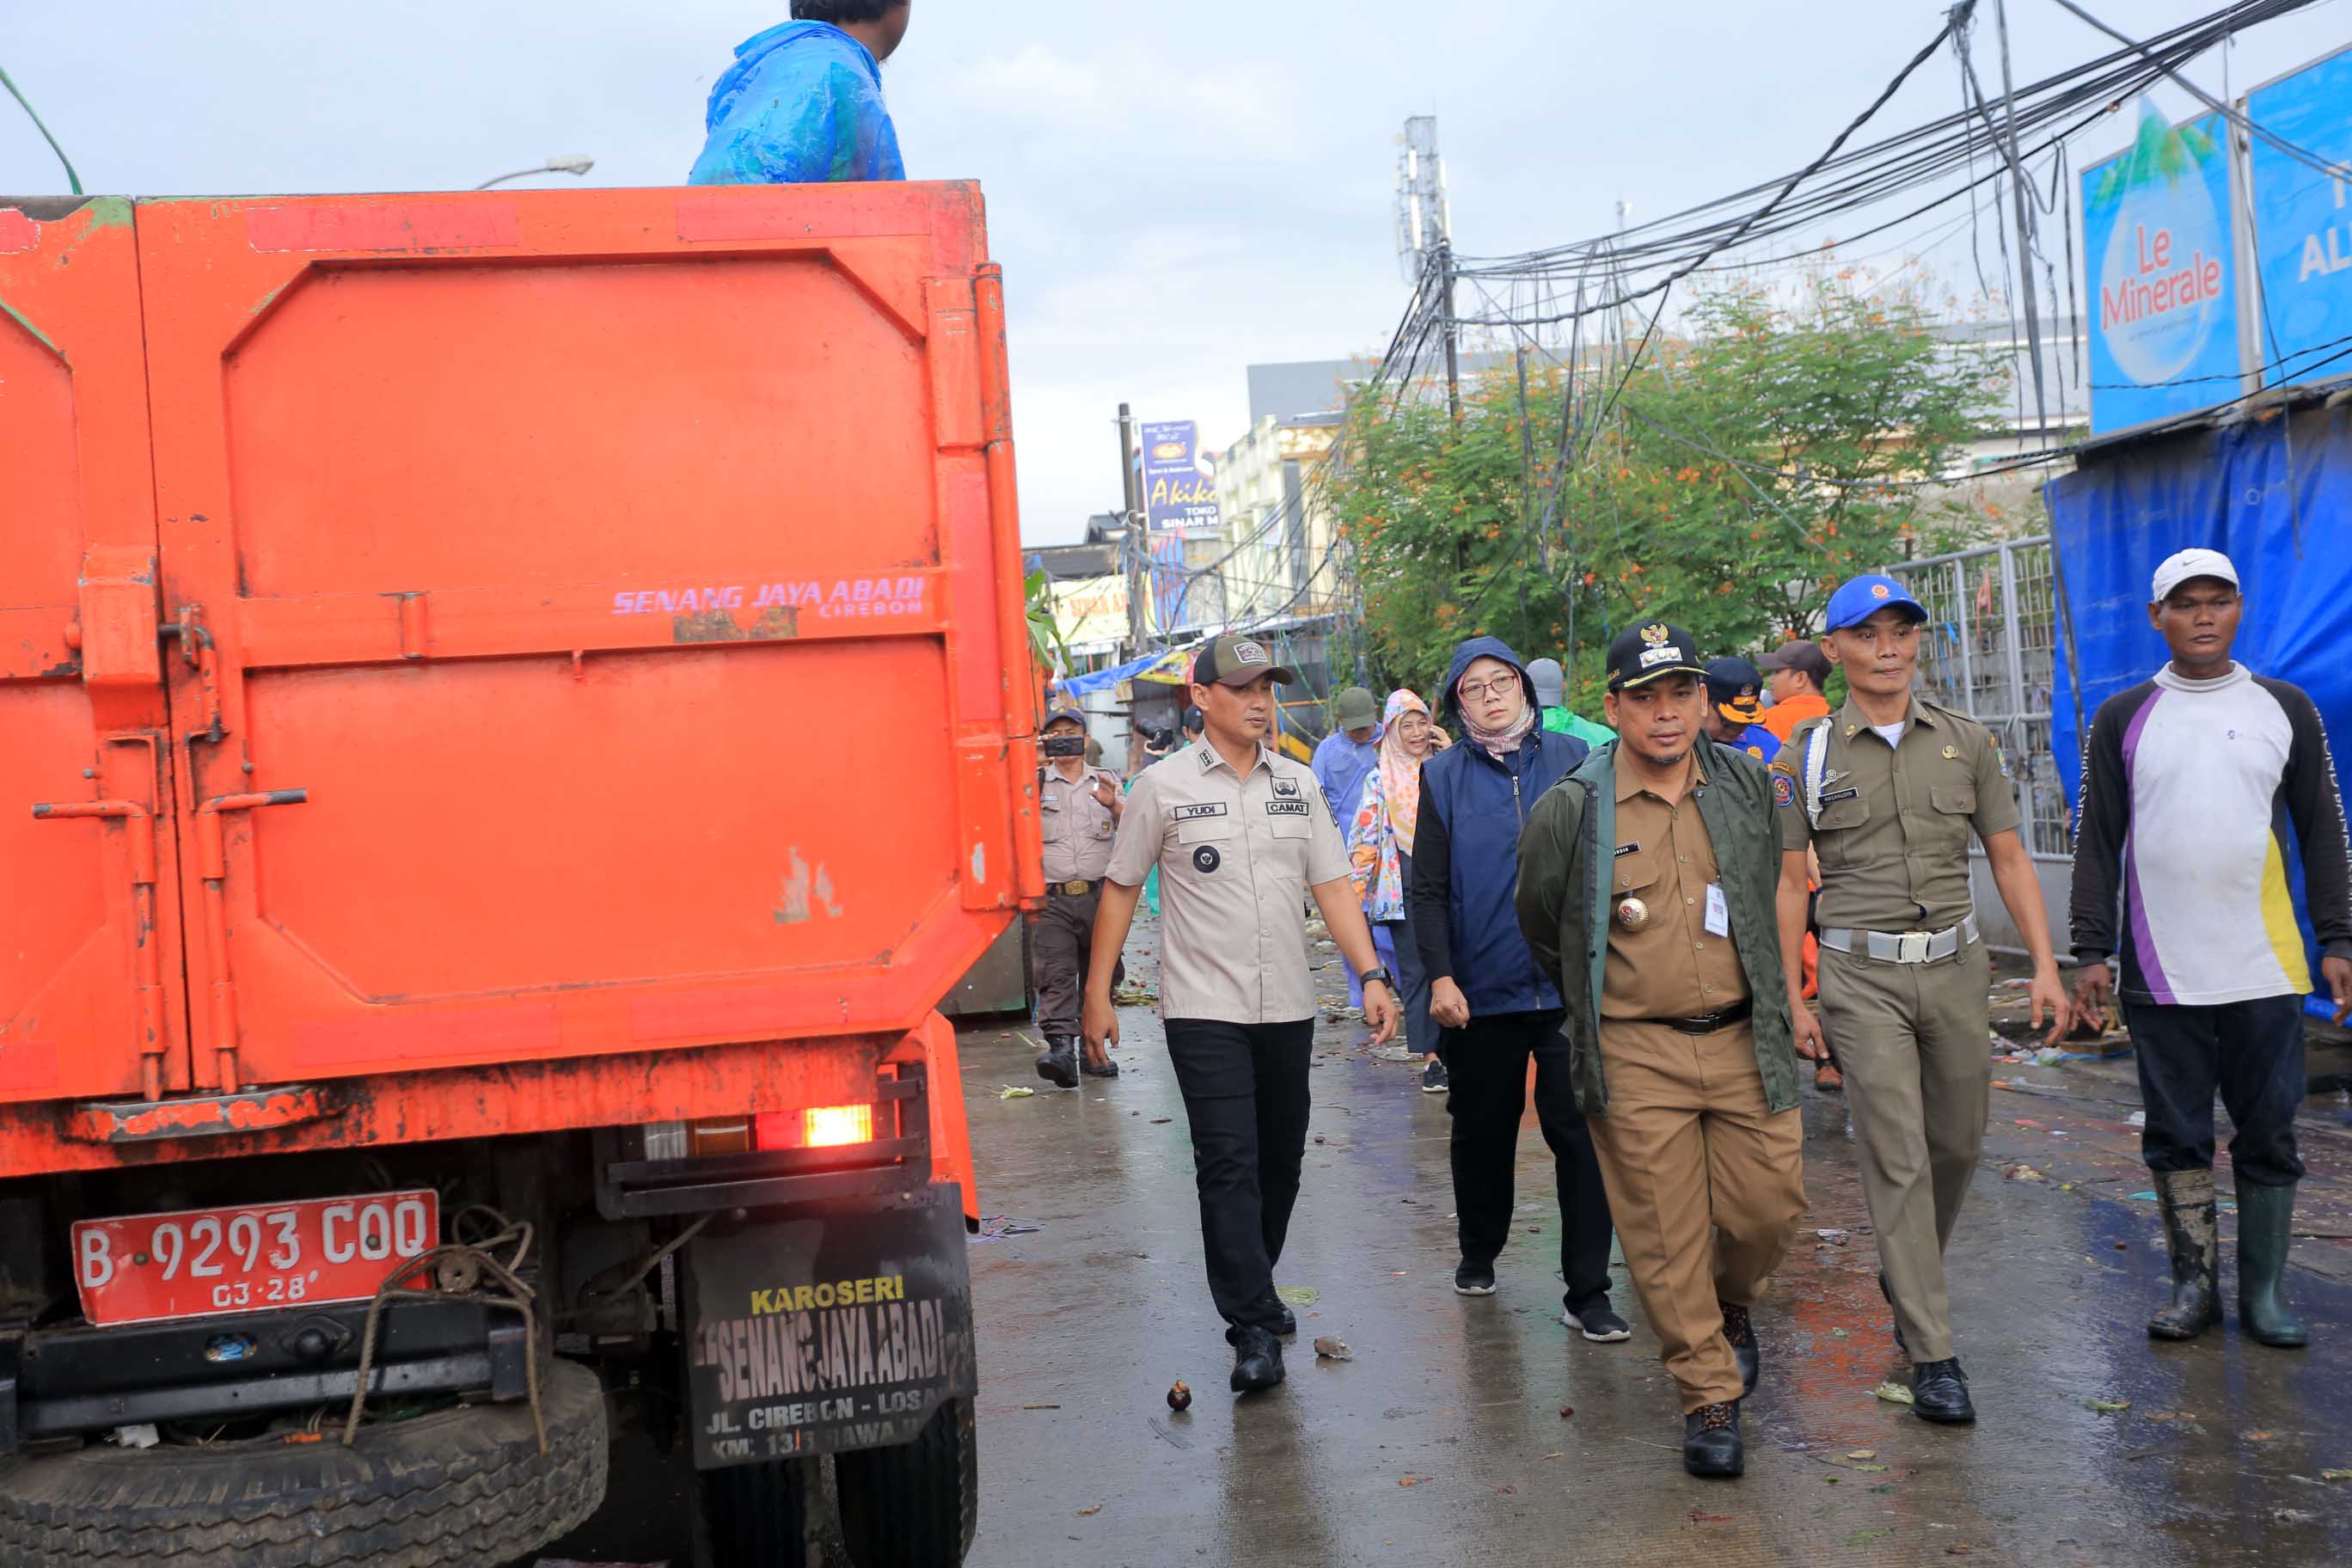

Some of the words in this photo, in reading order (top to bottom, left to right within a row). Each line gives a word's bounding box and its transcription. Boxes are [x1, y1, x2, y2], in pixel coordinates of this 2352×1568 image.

[2138, 226, 2170, 273] Le
[2298, 221, 2352, 282] AL
[2102, 252, 2220, 331] Minerale
[1161, 517, 1204, 529] SINAR
[1185, 505, 1216, 517] TOKO
[611, 586, 744, 615] SENANG
[752, 582, 822, 607] JAYA
[829, 577, 925, 603] ABADI
[1187, 805, 1216, 816] YUDI
[1271, 803, 1305, 813] CAMAT
[80, 1228, 113, 1289] B
[150, 1210, 301, 1280] 9293
[322, 1200, 427, 1265] COQ
[751, 1275, 905, 1314] KAROSERI
[706, 1412, 742, 1434] JL.
